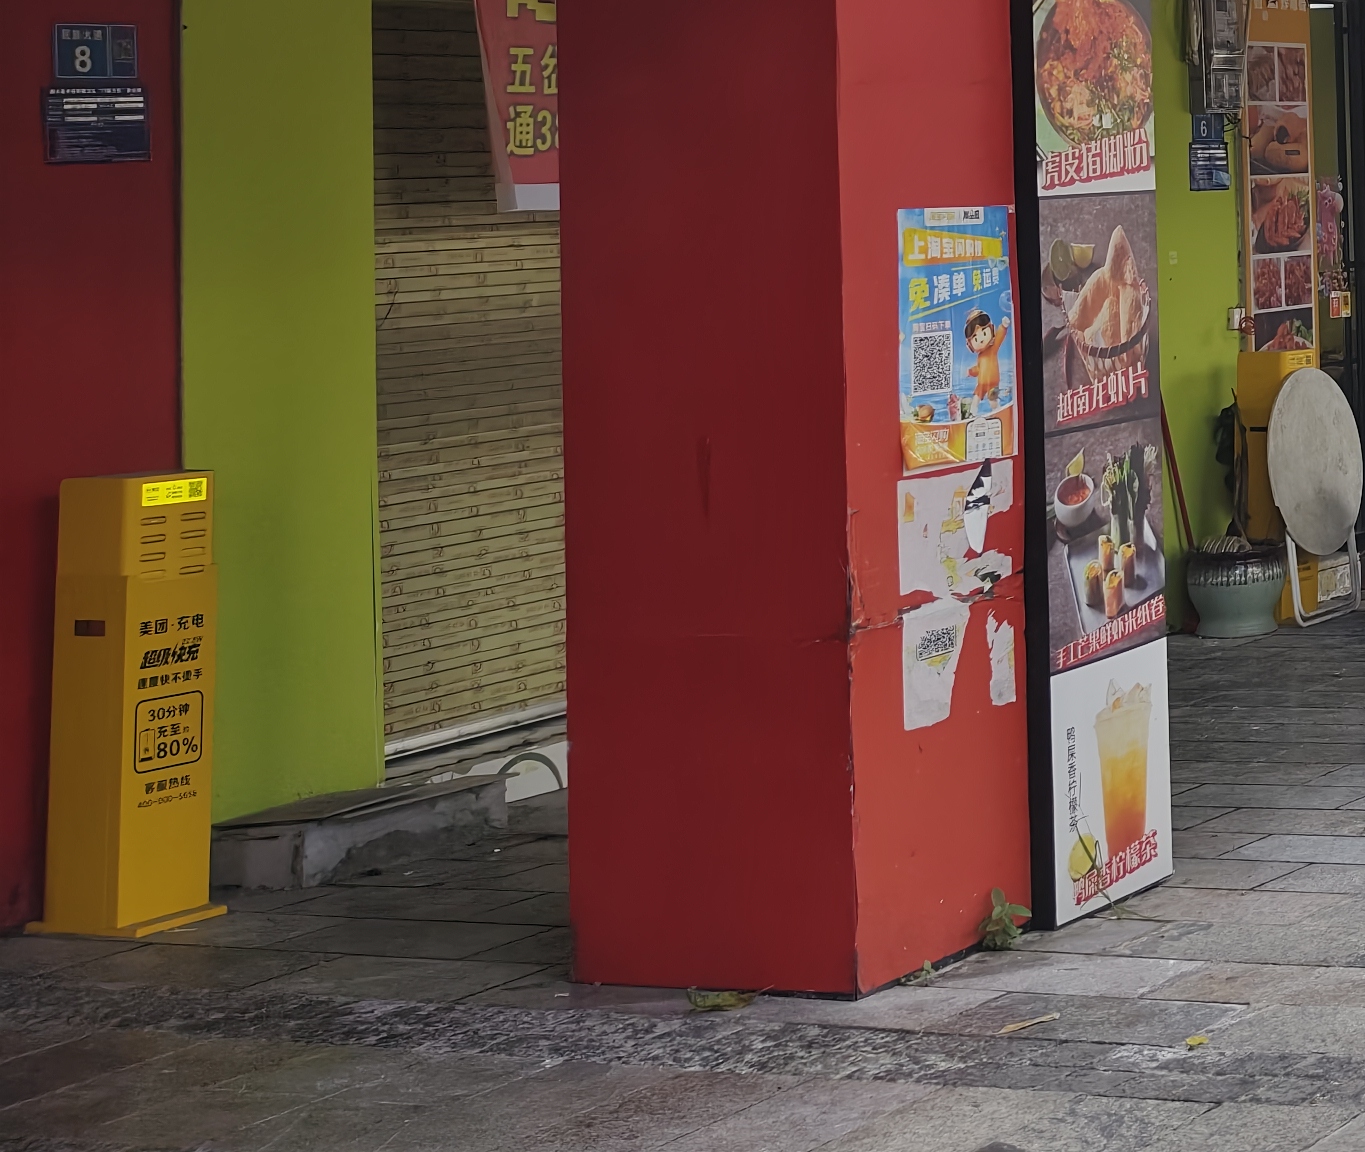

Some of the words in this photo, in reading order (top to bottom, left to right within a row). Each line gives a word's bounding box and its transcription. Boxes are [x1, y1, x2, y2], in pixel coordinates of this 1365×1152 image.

[74, 45, 92, 73] 8
[506, 105, 559, 157] 通3
[1200, 120, 1207, 137] 6
[1042, 128, 1149, 189] 虎皮猪脚粉
[909, 272, 966, 313] 免凑单
[1056, 361, 1148, 423] 越南龙虾片
[140, 643, 201, 669] 超级快充
[148, 703, 190, 721] 30分钟
[157, 736, 198, 759] 80%
